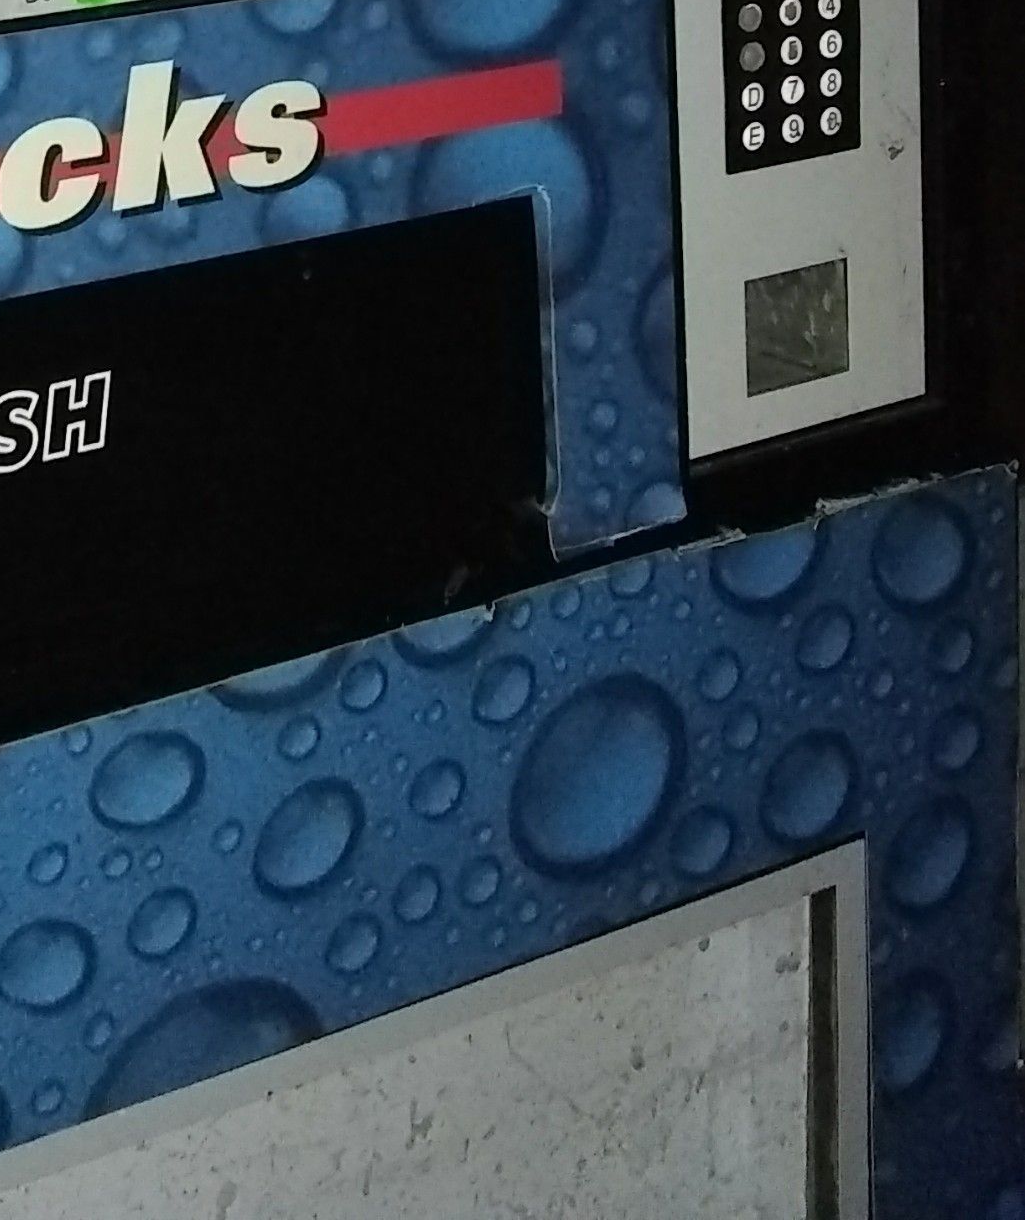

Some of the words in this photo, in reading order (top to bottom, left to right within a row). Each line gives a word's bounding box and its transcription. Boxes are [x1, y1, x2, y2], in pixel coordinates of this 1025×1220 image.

[826, 33, 838, 54] 6
[787, 79, 799, 100] 7
[826, 72, 837, 93] 8
[748, 87, 761, 108] D
[748, 125, 761, 147] E
